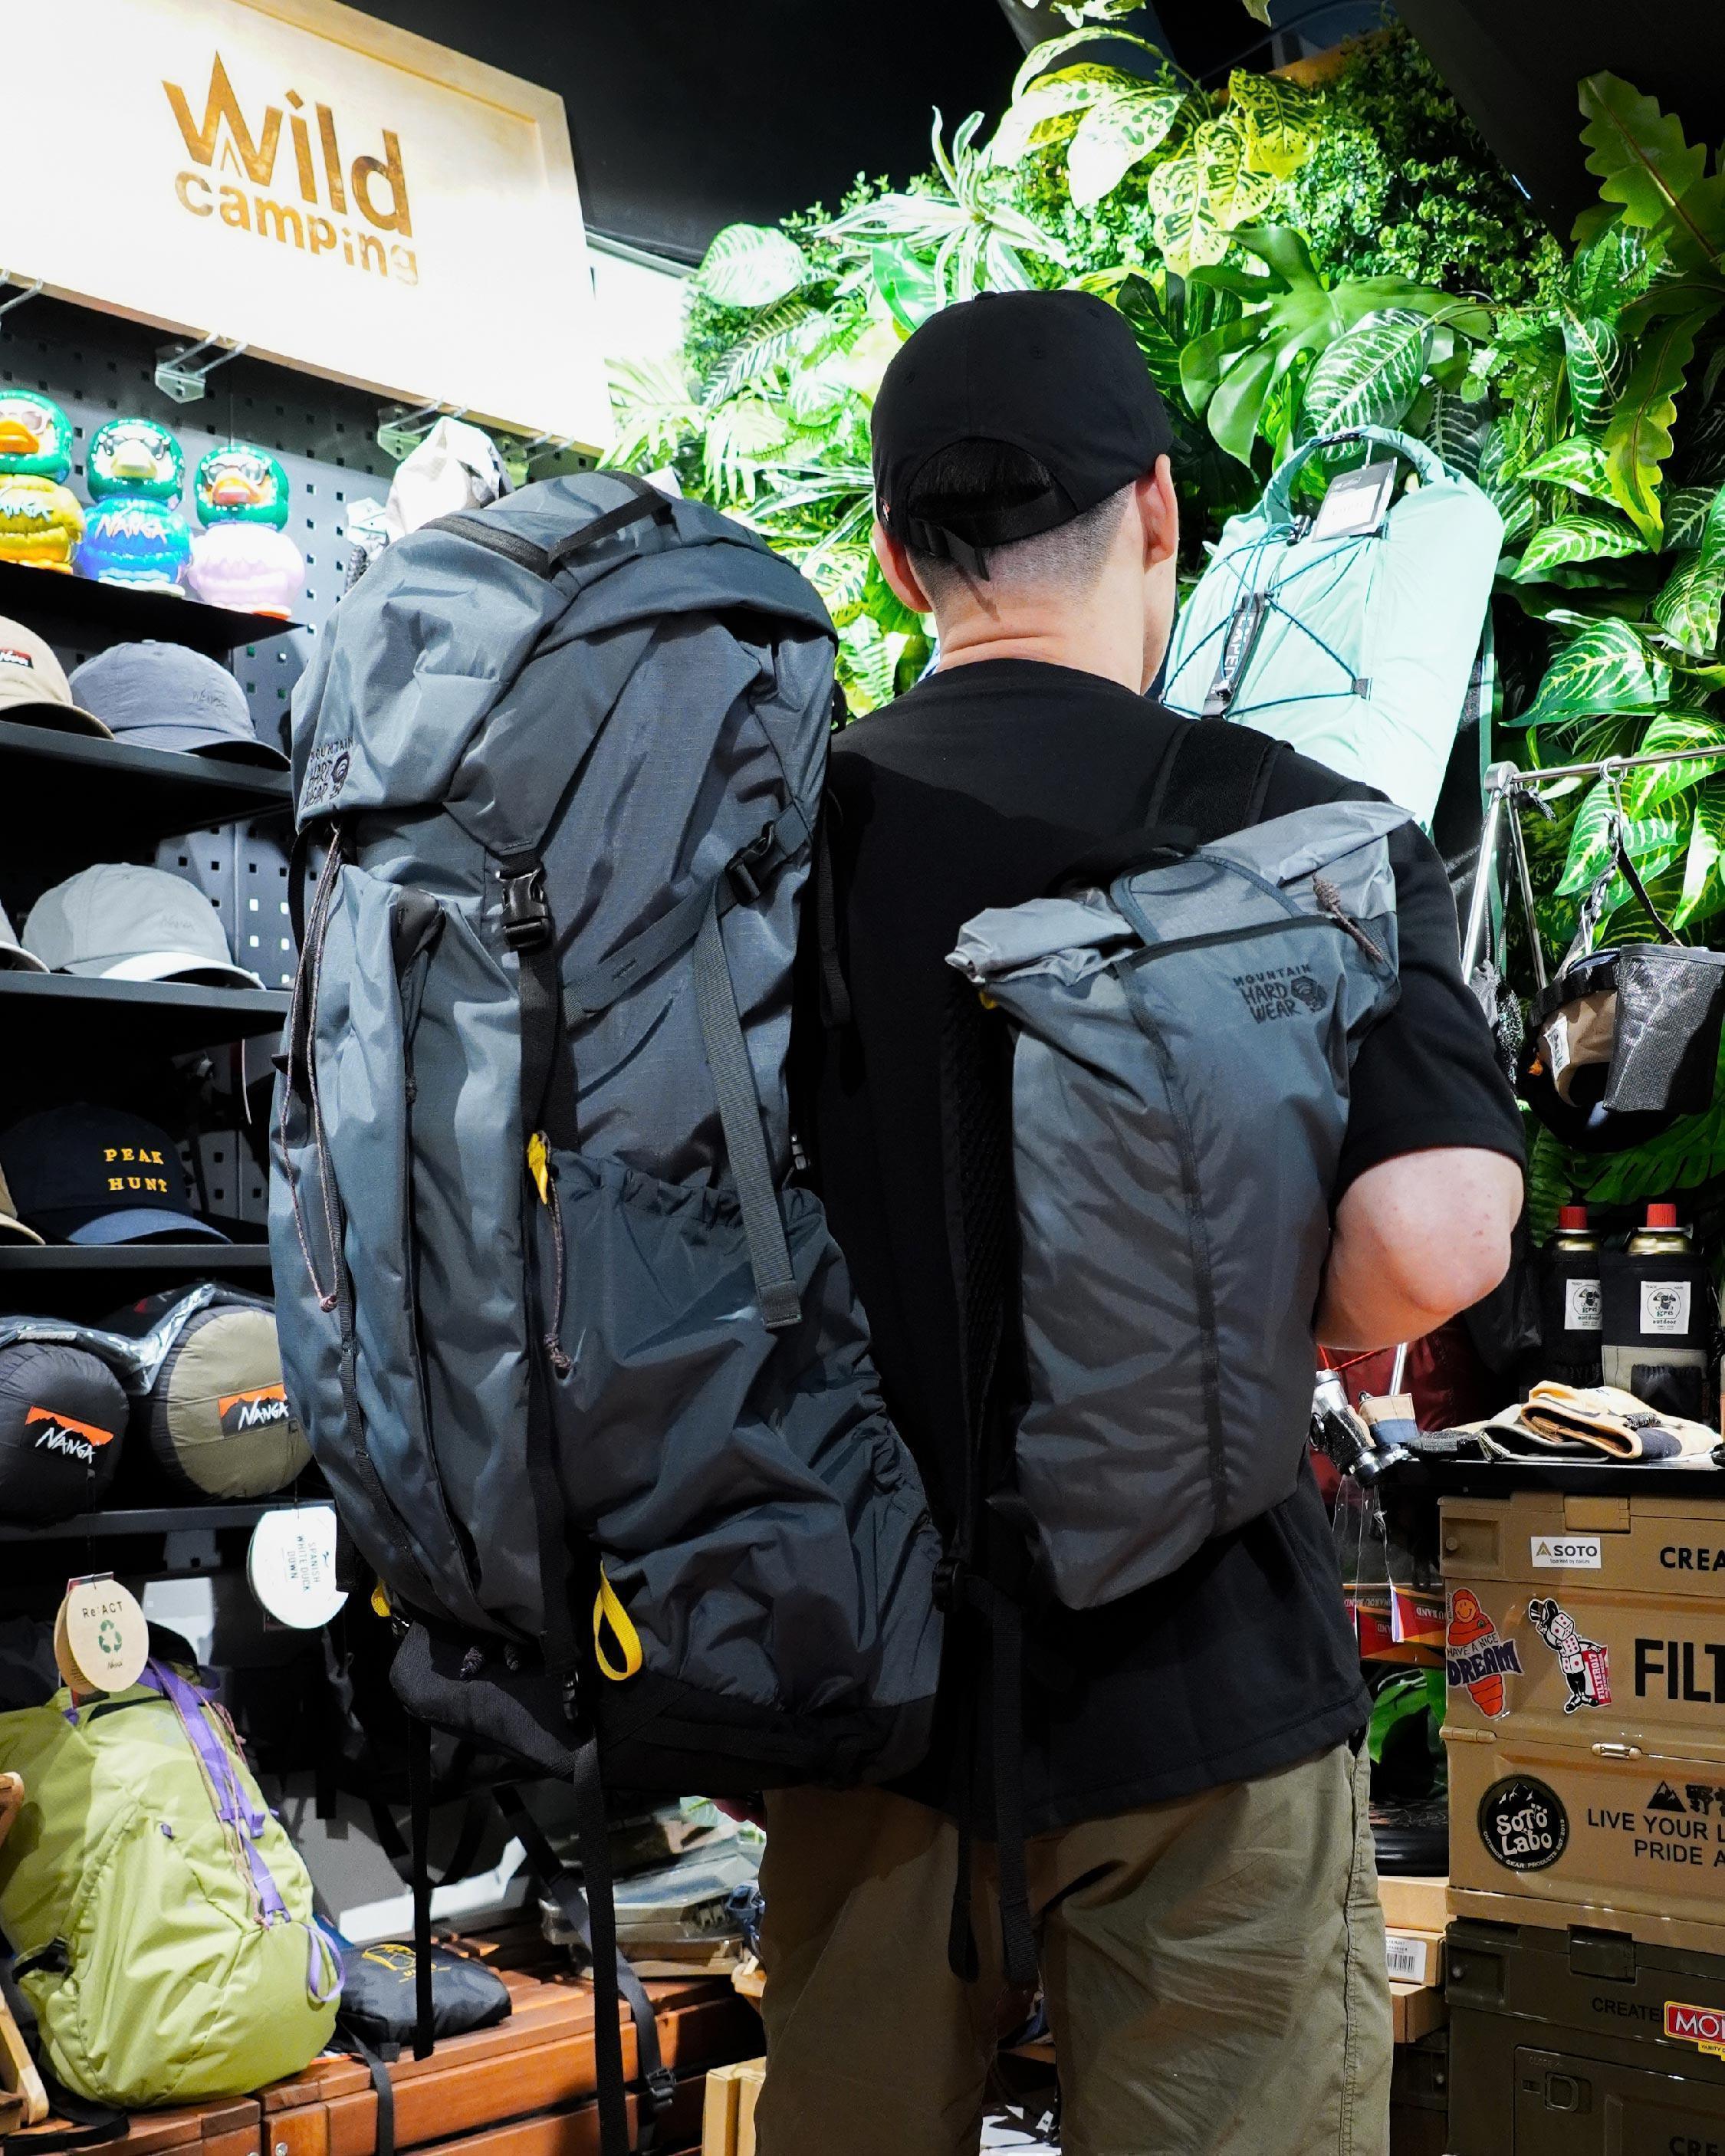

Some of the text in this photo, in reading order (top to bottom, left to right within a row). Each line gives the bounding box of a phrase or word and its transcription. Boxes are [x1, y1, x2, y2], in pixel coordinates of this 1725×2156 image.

[161, 49, 412, 238] Wild
[175, 170, 419, 286] camping
[1233, 965, 1312, 987] MOUNTAIN
[1240, 982, 1288, 1006] HARD
[1250, 999, 1303, 1024] WEAR
[104, 1149, 164, 1165] PEAK
[107, 1177, 168, 1192] HUNT
[238, 1396, 289, 1431] NANGA
[34, 1427, 97, 1464] NANGA
[287, 1550, 299, 1579] DOWN
[296, 1536, 311, 1592] WHITE DUCK
[307, 1542, 321, 1582] SPANISH
[1553, 1545, 1598, 1557] SOTO
[1447, 1633, 1500, 1657] HAVE A NICE
[1447, 1641, 1522, 1686] DREAM
[1635, 1638, 1725, 1704] FILT
[1588, 1809, 1635, 1831] LIVE
[1643, 1815, 1708, 1840] YOUR
[1502, 1829, 1552, 1855] Labo
[1635, 1839, 1703, 1865] PRIDE
[1592, 1997, 1664, 2023] CREATE
